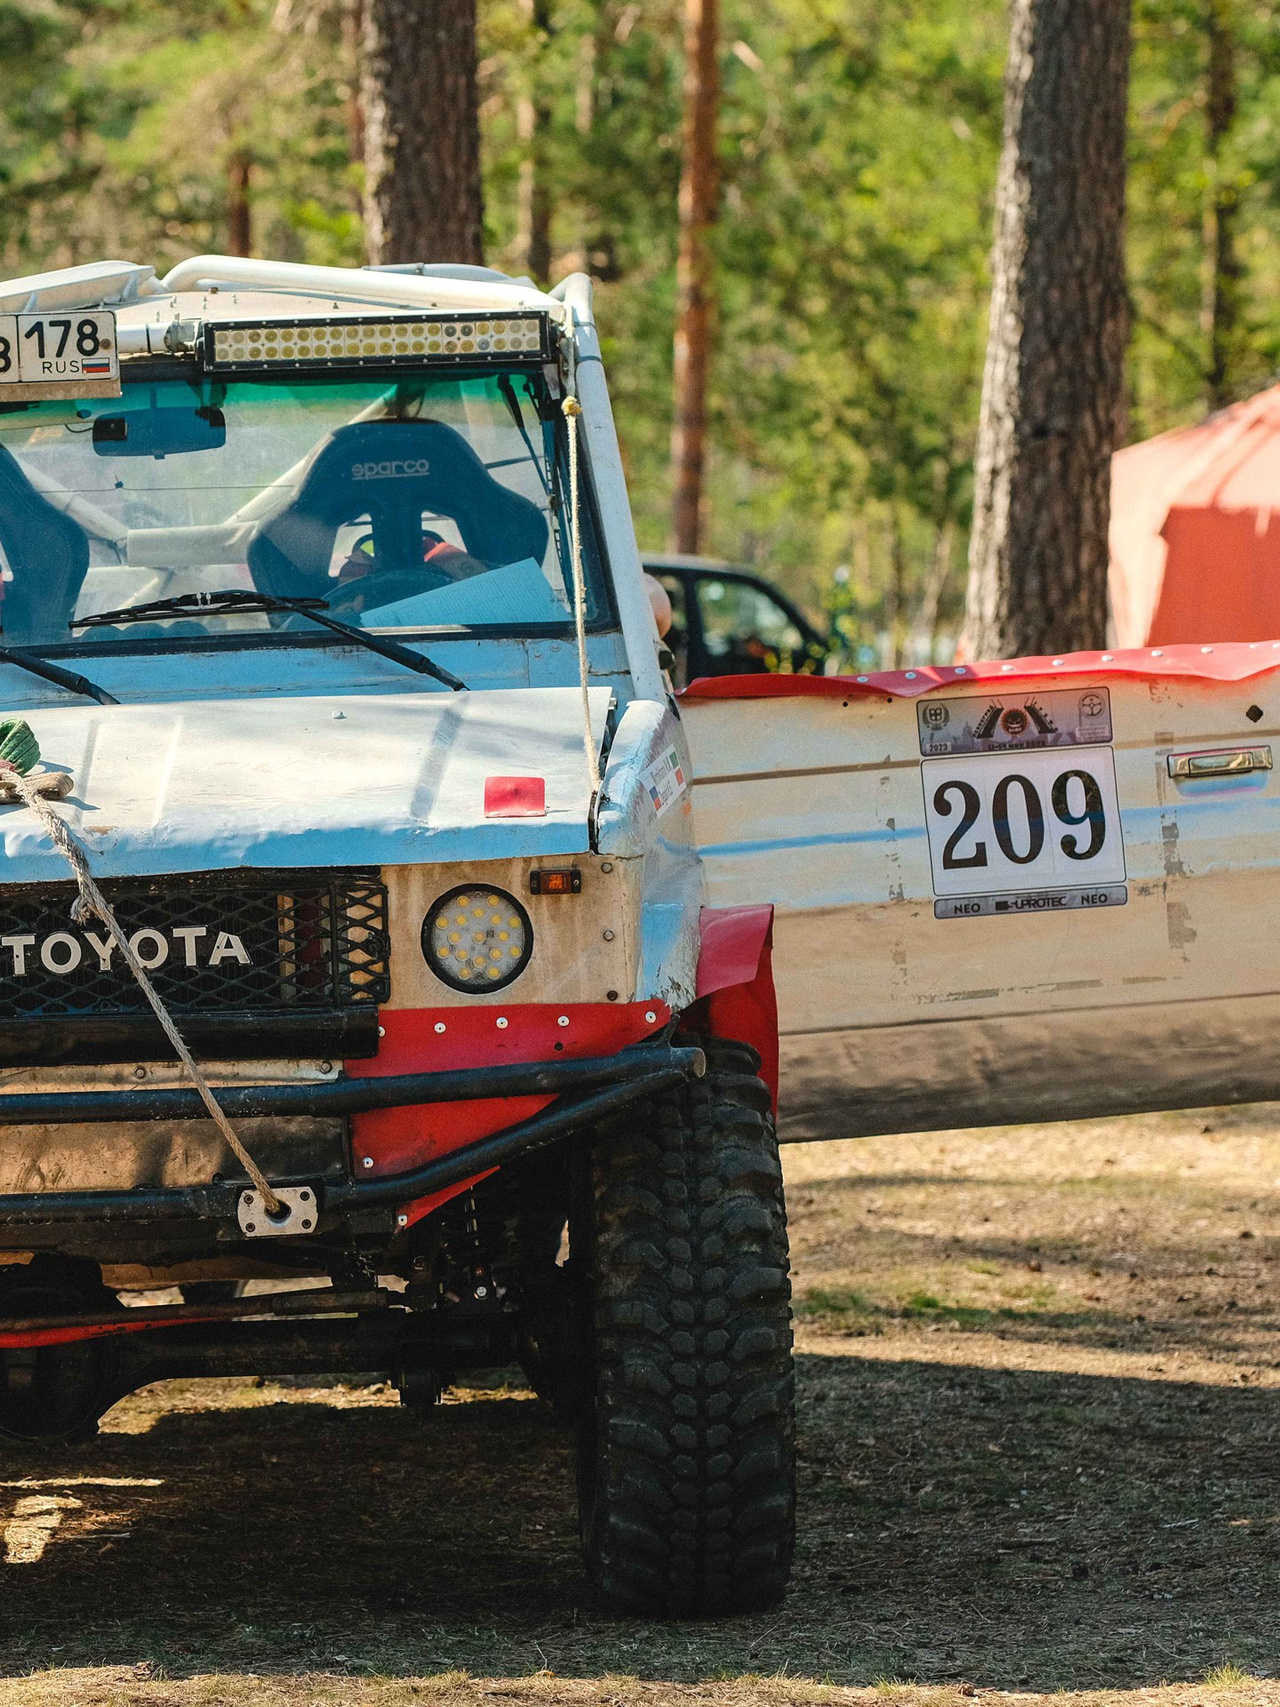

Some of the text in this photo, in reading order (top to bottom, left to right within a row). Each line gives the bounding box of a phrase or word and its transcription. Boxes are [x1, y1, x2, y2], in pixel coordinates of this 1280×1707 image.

[24, 319, 100, 359] 178
[42, 360, 80, 374] RUS
[351, 458, 430, 480] sparco
[929, 743, 948, 752] 2023
[933, 769, 1106, 870] 209
[954, 902, 981, 914] NEO
[1008, 896, 1067, 910] SUPROTEC
[1081, 893, 1108, 905] NEO
[0, 926, 253, 976] TOYOTA
